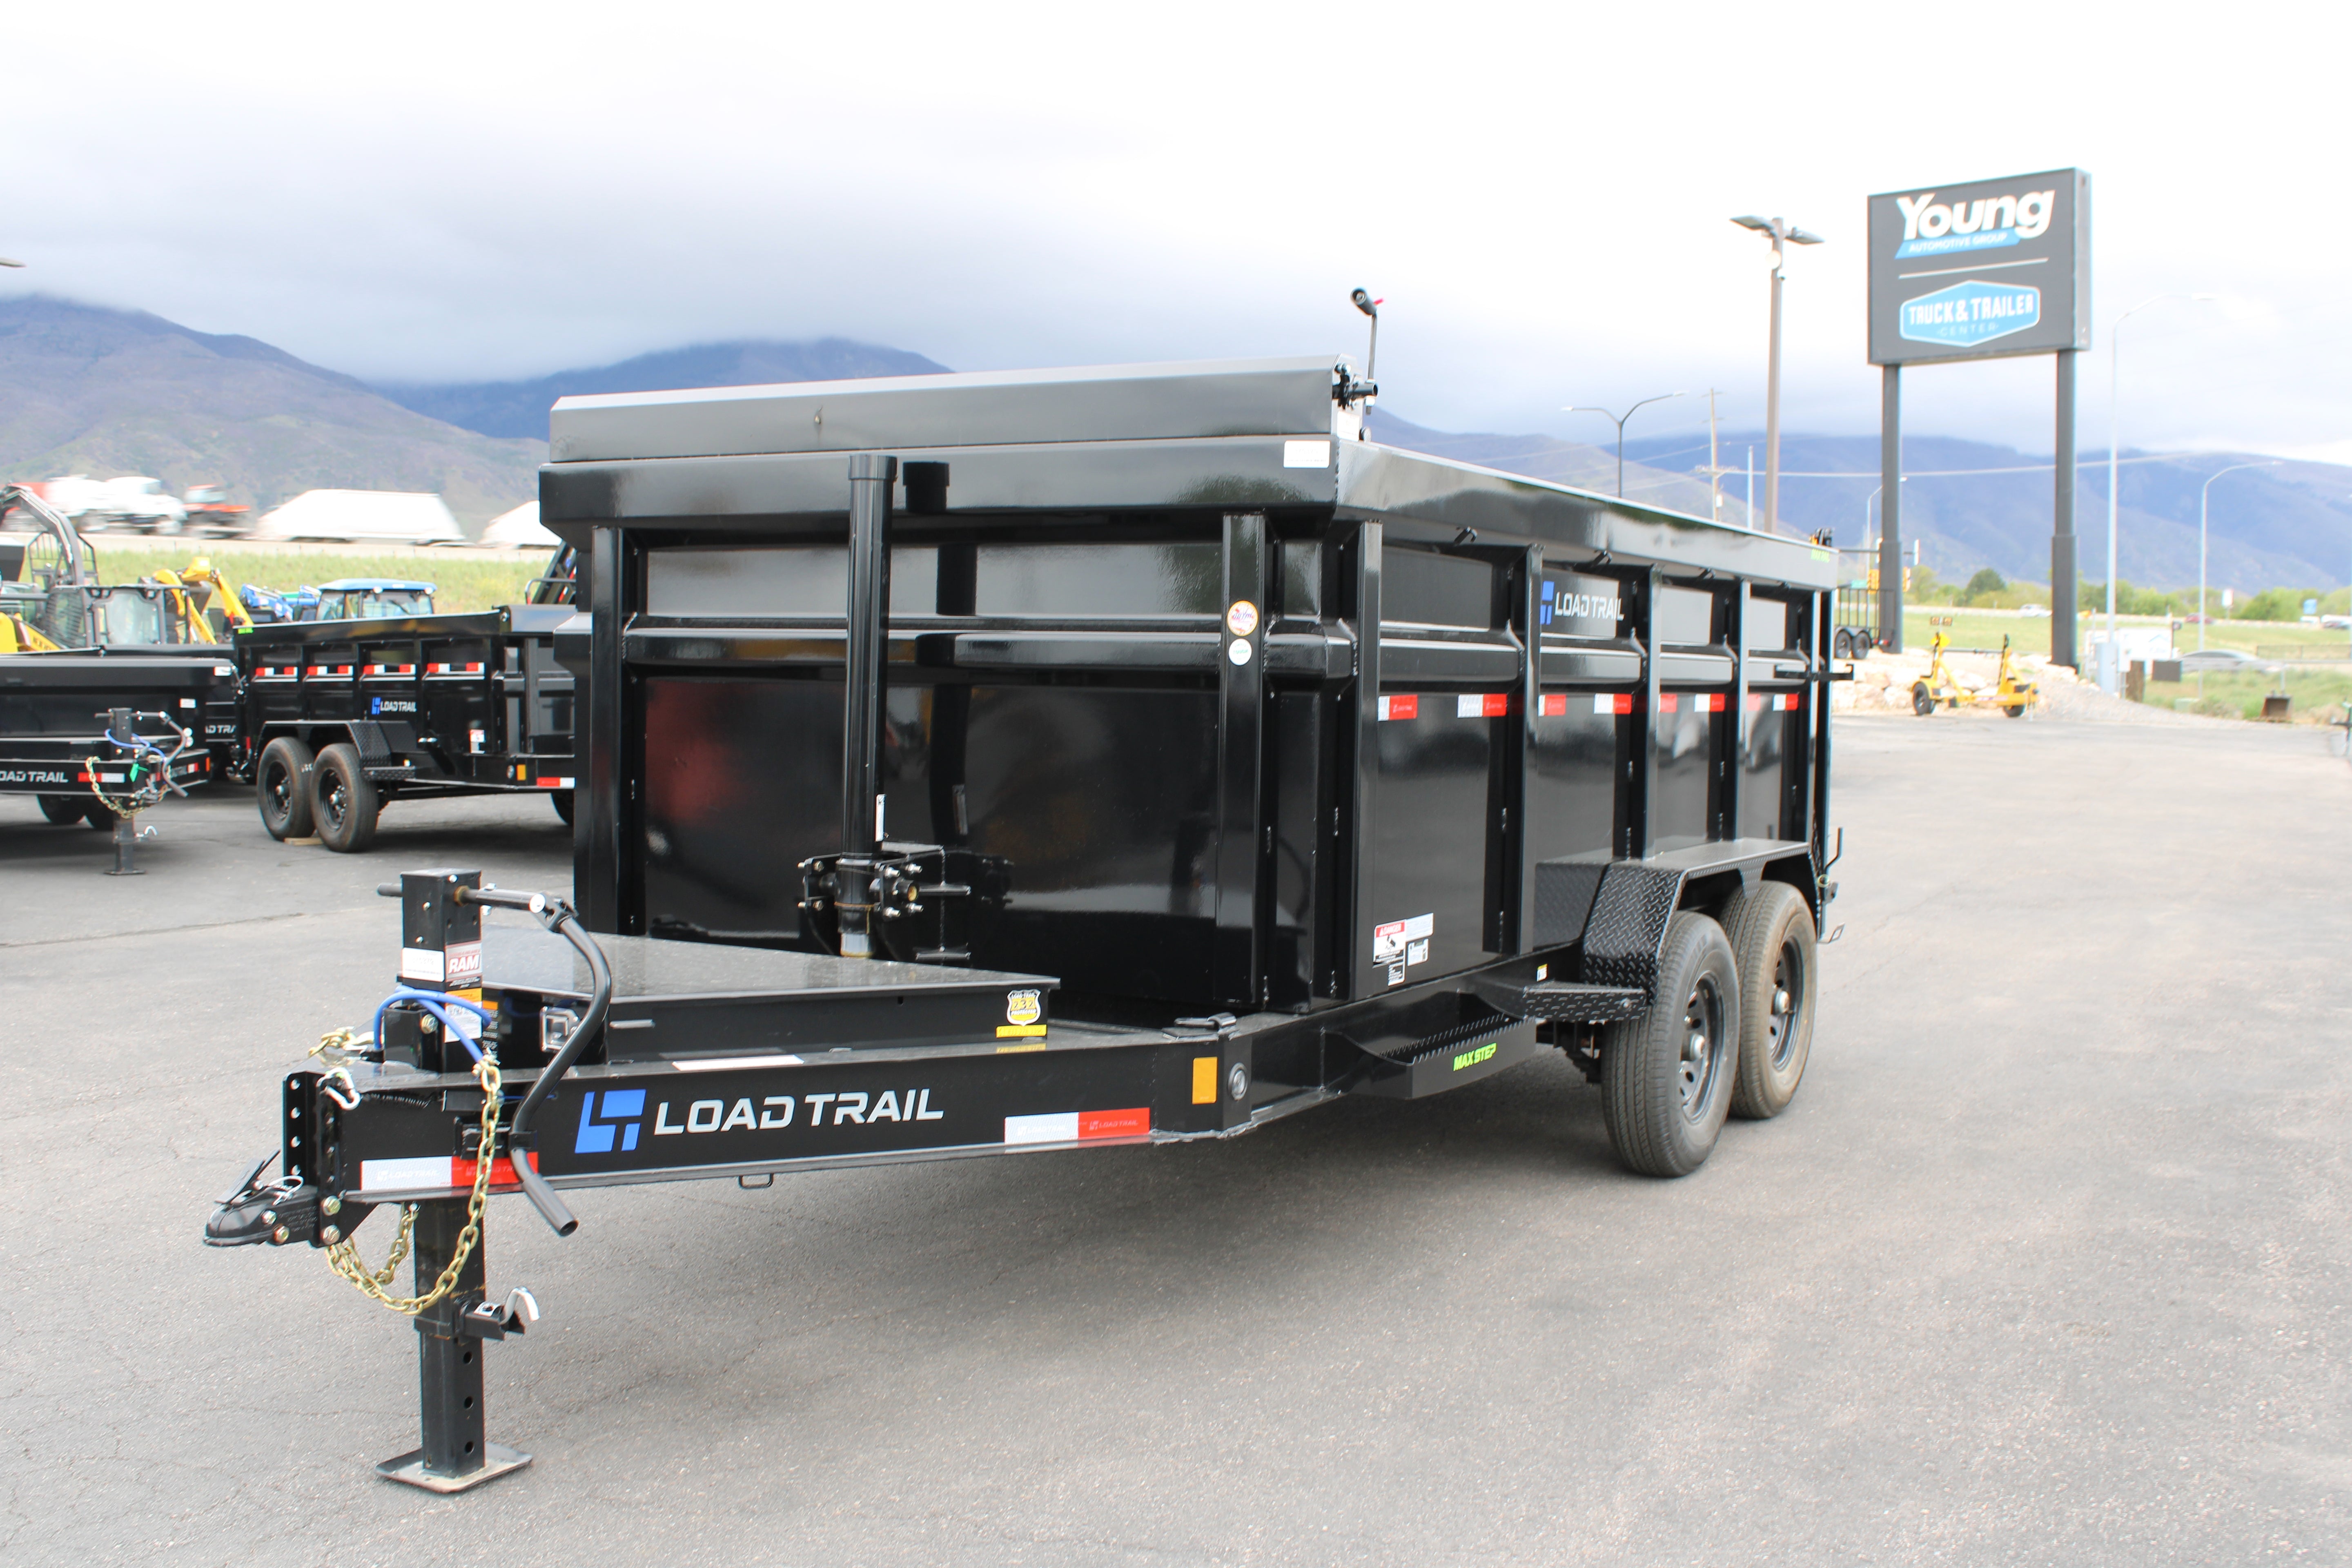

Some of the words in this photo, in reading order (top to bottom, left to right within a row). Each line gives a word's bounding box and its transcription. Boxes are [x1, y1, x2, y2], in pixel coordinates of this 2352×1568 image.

[1896, 189, 2055, 240] Young
[1909, 236, 1971, 253] AUTOMOTIVE
[1972, 232, 2008, 244] GROUP
[1908, 301, 1955, 325] TRUCK
[1970, 294, 2034, 321] TRAILER
[1940, 323, 1997, 337] CENTER
[1555, 592, 1589, 618] LOAD
[1591, 595, 1624, 621] TRAIL
[380, 701, 398, 711] LOAD
[398, 701, 416, 712] TRAIL
[0, 771, 27, 782] OAD
[27, 771, 69, 783] TRAIL
[448, 954, 481, 974] RAM
[1453, 1050, 1474, 1071] MAX
[1474, 1042, 1497, 1064] STEP
[654, 1095, 796, 1136] LOAD
[804, 1088, 945, 1127] TRAIL
